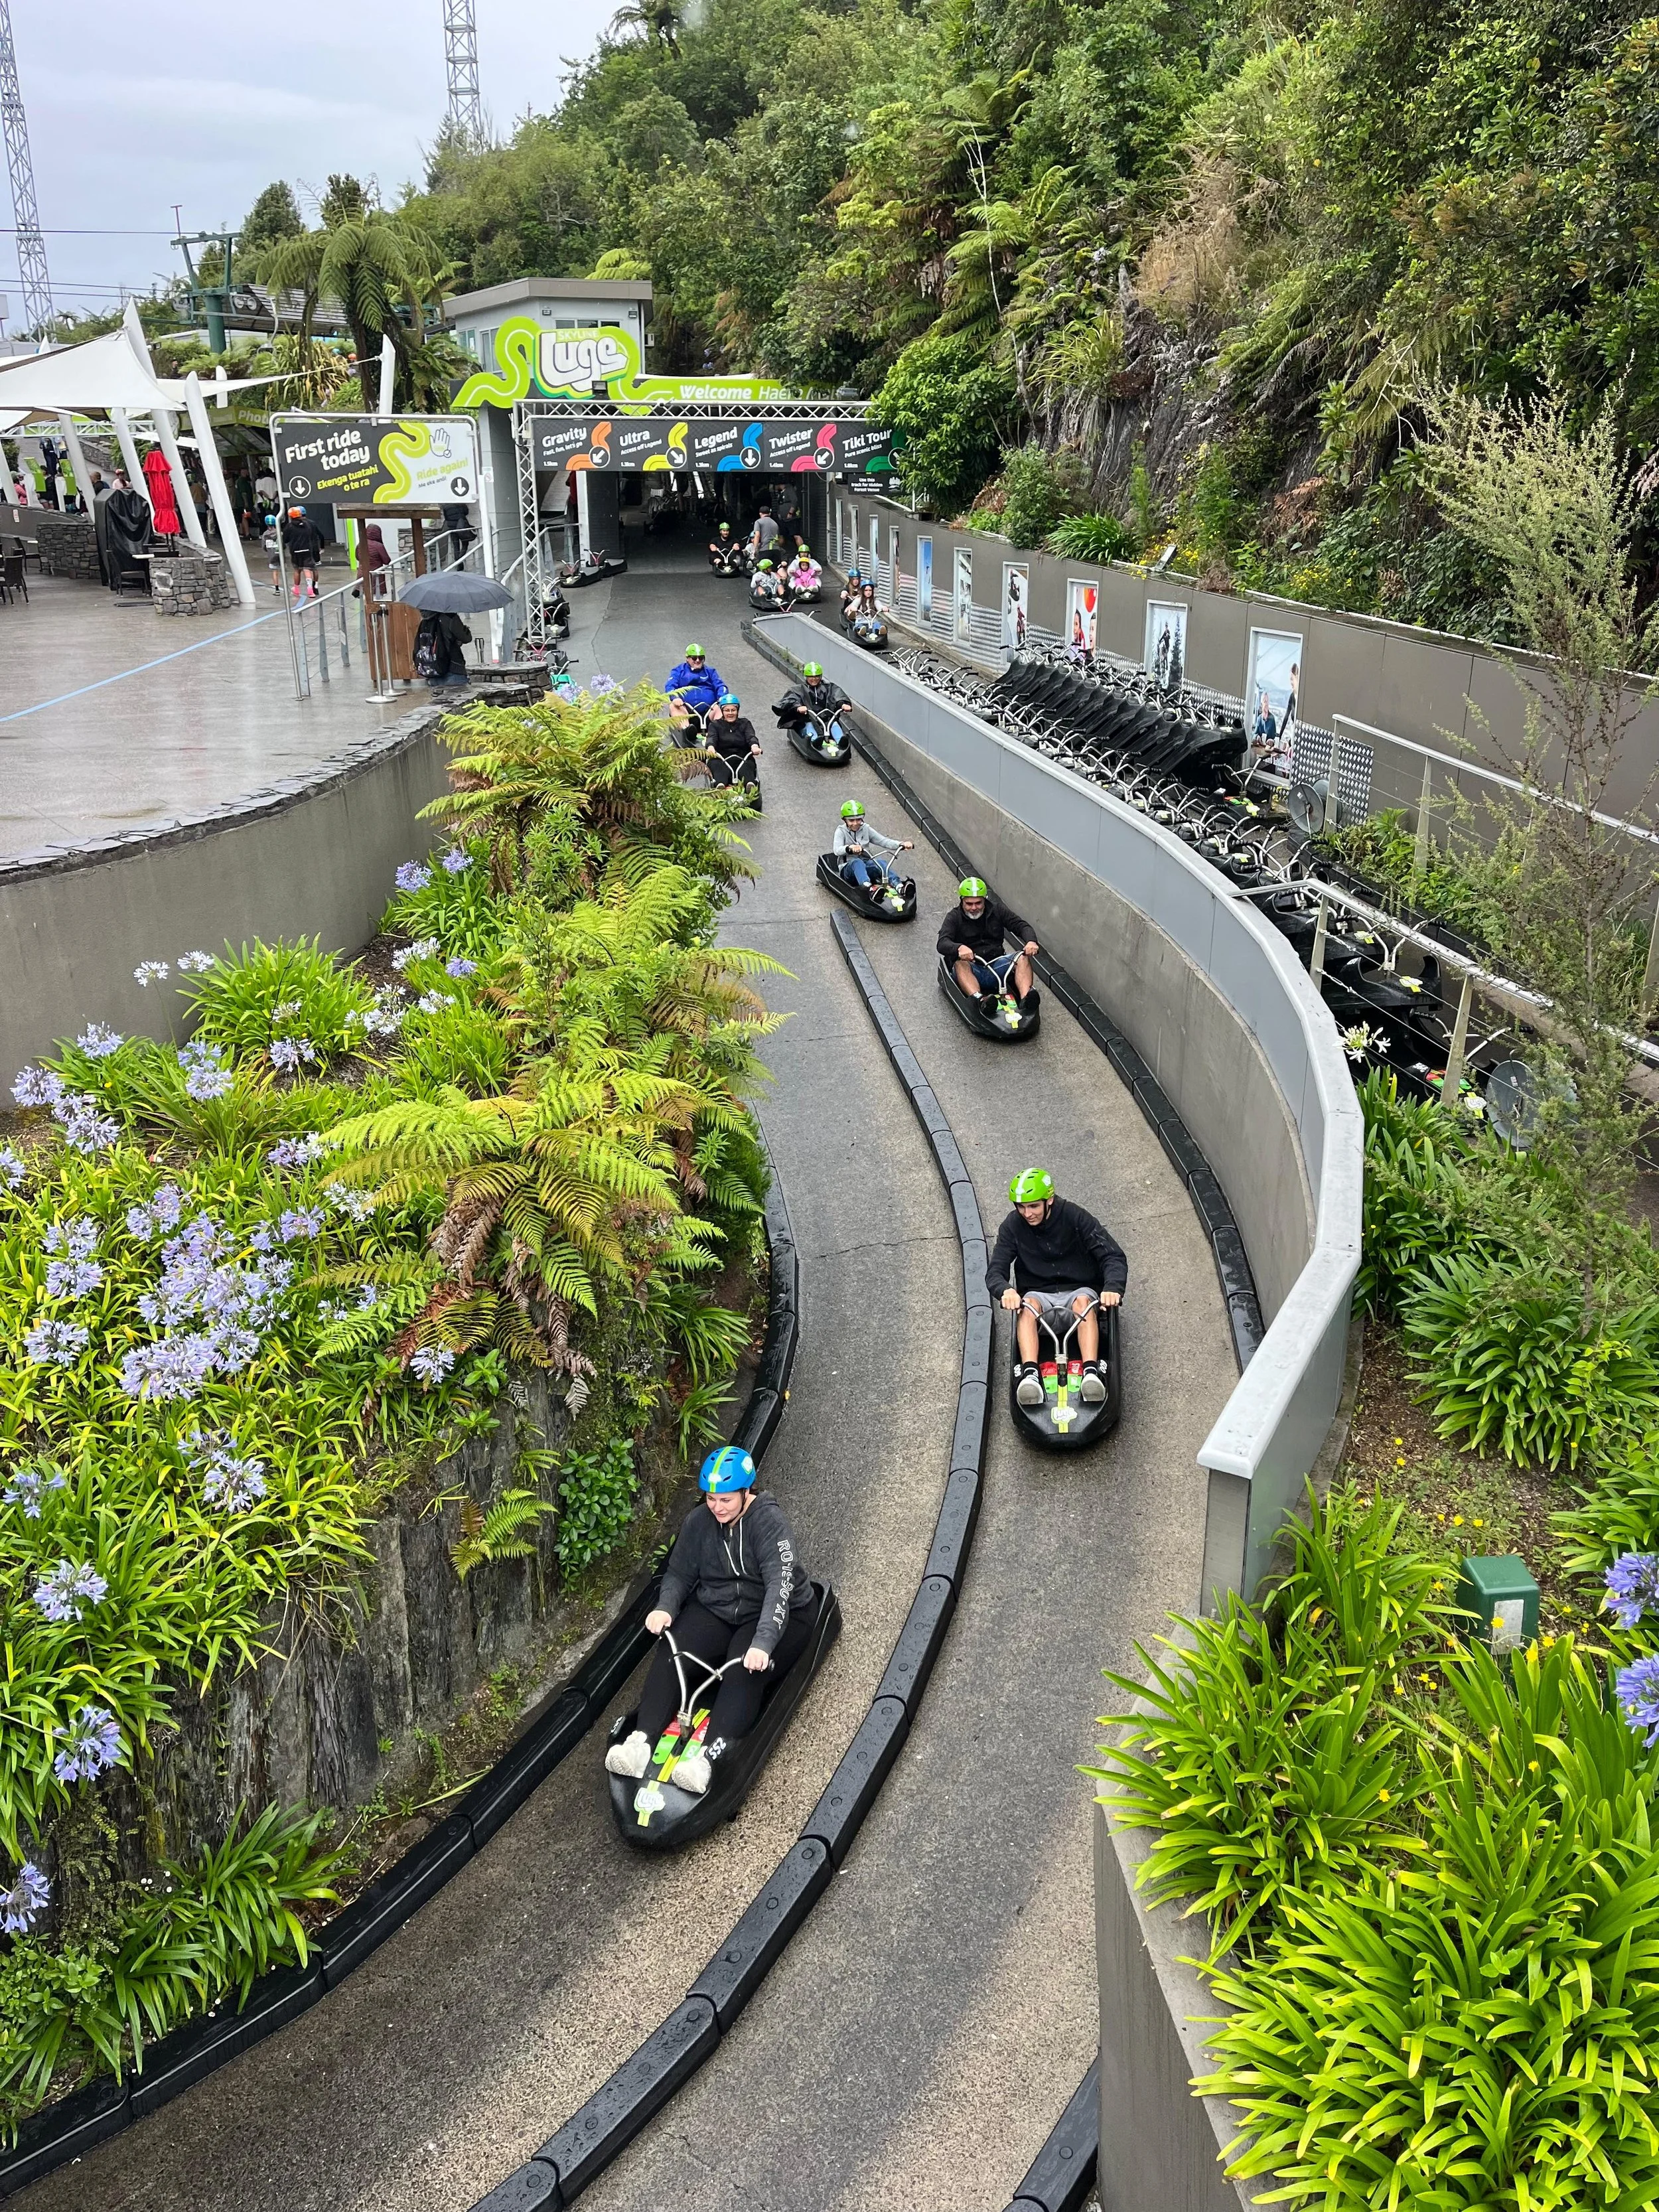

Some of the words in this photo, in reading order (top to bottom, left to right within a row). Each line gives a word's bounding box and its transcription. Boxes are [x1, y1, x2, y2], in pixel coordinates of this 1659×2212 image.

[540, 332, 628, 393] Luge
[680, 384, 752, 400] Welcome
[285, 438, 325, 464] First
[326, 429, 362, 451] ride
[542, 427, 587, 447] Gravity
[619, 430, 650, 447] Ultra
[620, 447, 637, 455] Access
[644, 439, 662, 449] Legend
[694, 426, 738, 449] Legend
[768, 428, 814, 449] Twister
[793, 441, 811, 450] Legend
[842, 434, 866, 451] Tiki
[866, 429, 893, 444] Tour
[321, 445, 370, 471] today
[416, 467, 439, 481] Ride
[439, 457, 469, 474] again!
[317, 475, 348, 490] Ekenga
[348, 464, 379, 480] tuatahi
[350, 481, 360, 490] te
[708, 1736, 727, 1760] 552
